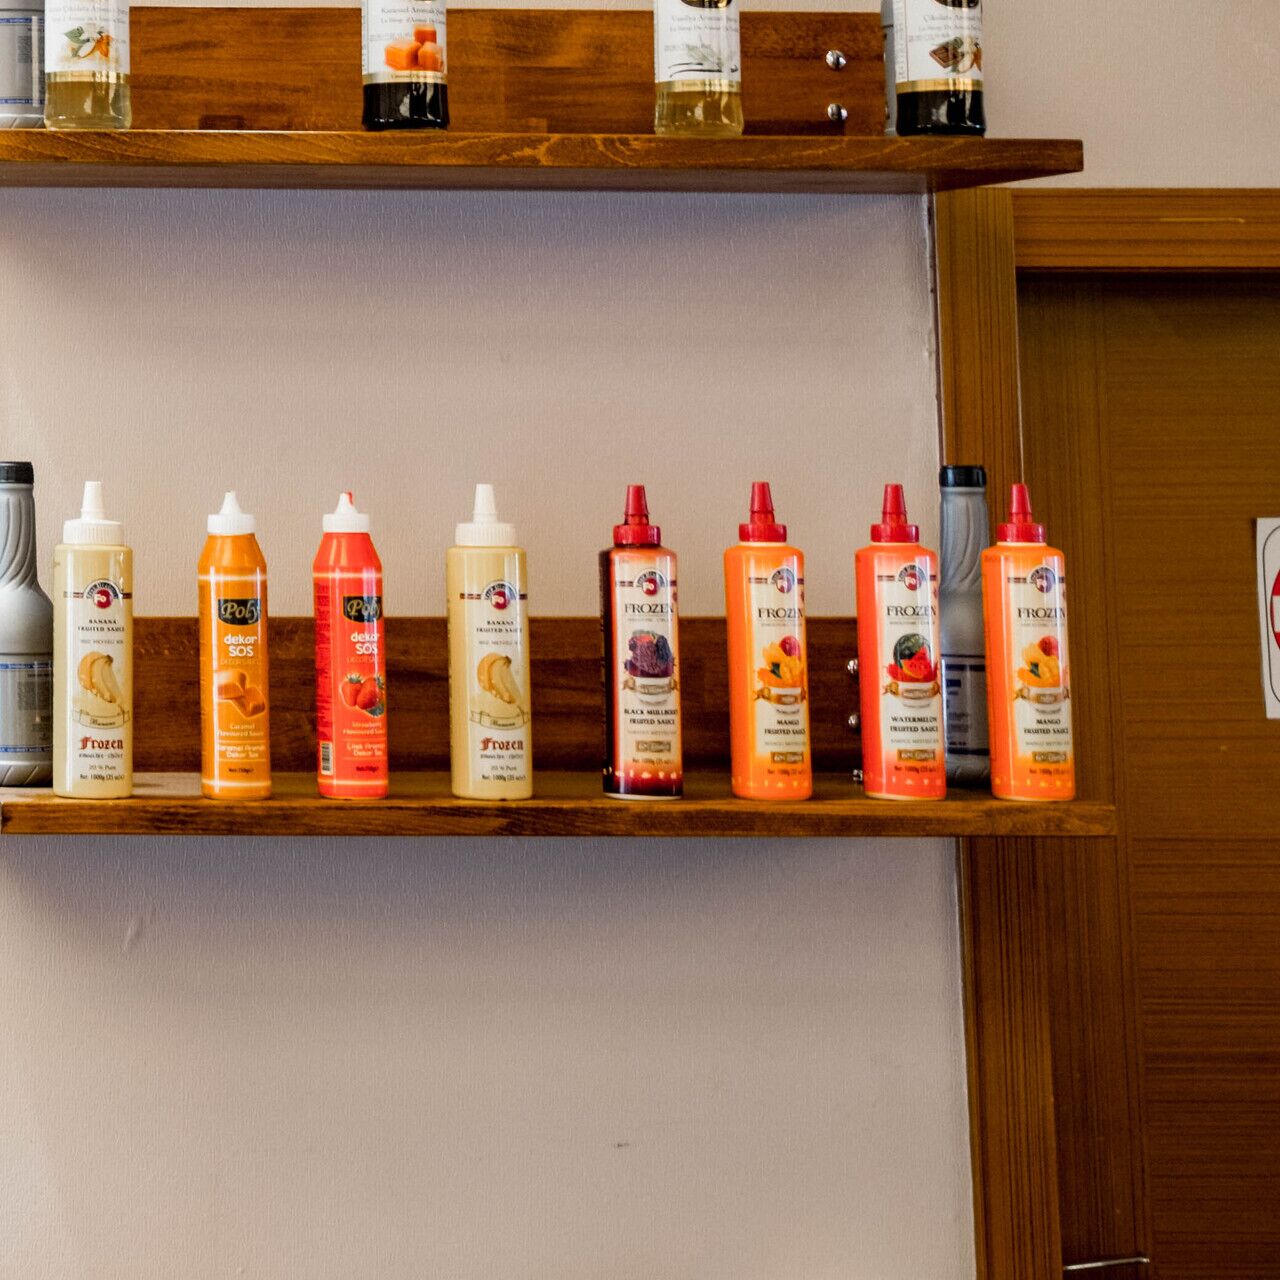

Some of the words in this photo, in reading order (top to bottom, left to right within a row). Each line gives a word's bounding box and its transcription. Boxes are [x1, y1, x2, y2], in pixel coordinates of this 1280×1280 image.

[221, 600, 258, 624] Poly
[347, 597, 380, 621] Poly
[223, 633, 258, 645] dekor
[228, 645, 254, 657] SOS
[355, 643, 378, 656] SOS
[79, 736, 124, 750] Frozen
[479, 736, 524, 751] Frozen
